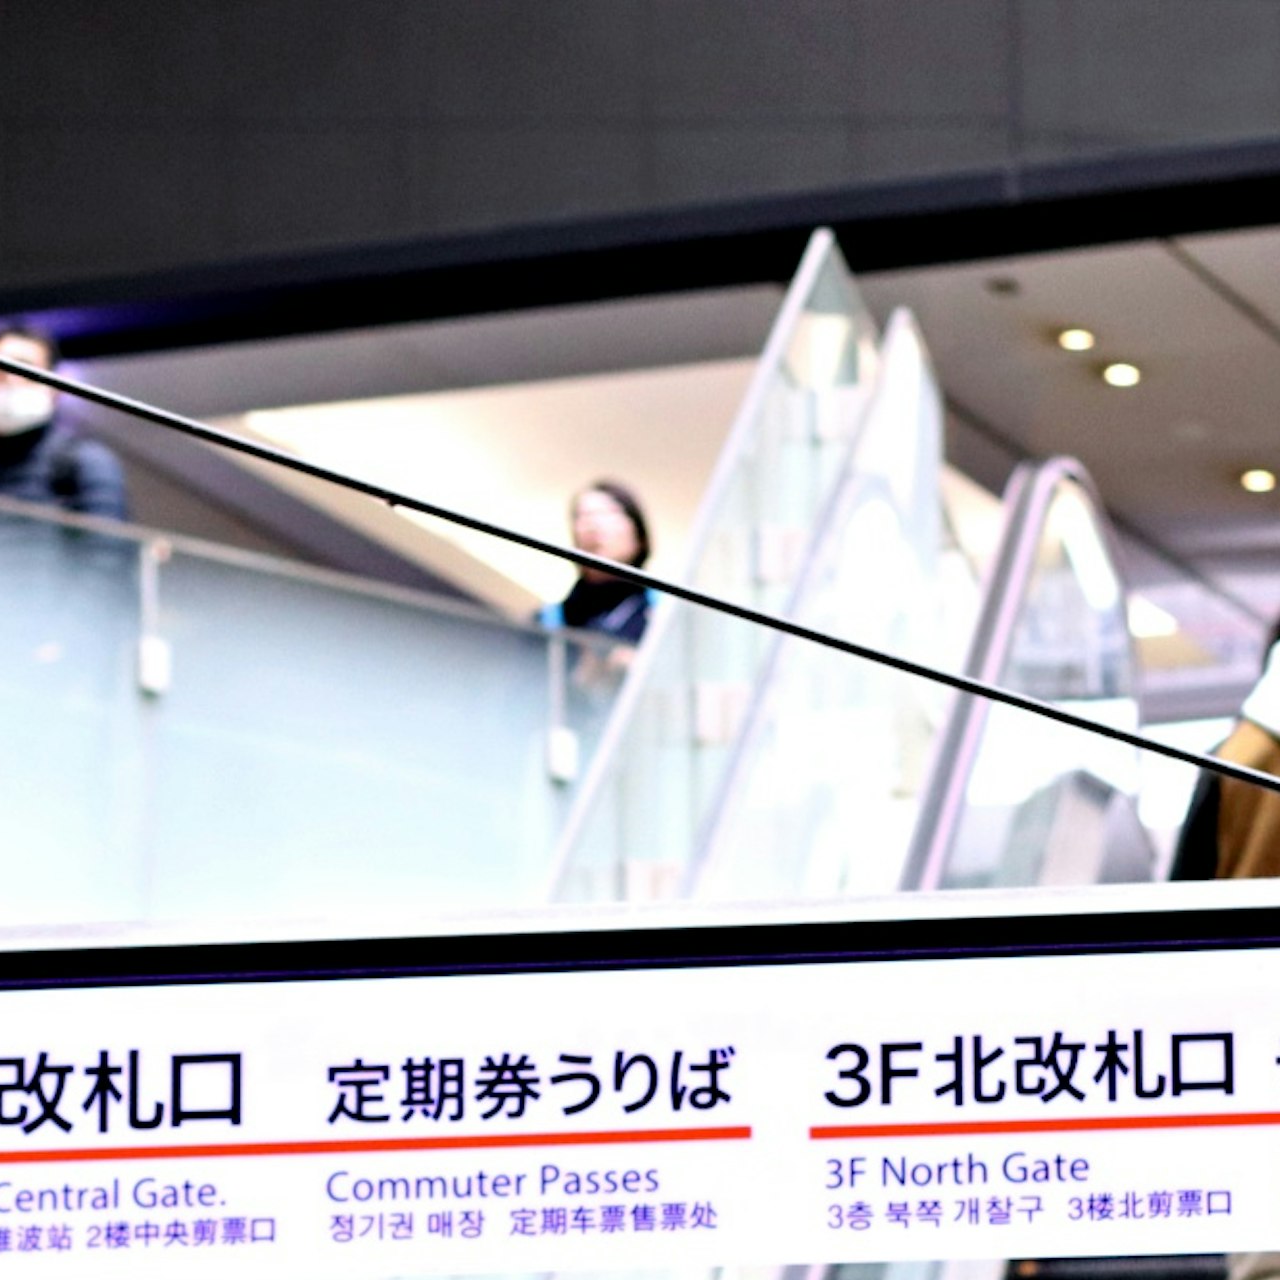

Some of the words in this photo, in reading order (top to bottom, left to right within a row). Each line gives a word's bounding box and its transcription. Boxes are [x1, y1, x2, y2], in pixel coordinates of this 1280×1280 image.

[327, 1046, 735, 1124] 定期券うりば
[824, 1029, 1234, 1108] 3F北改札口
[326, 1170, 526, 1202] Commuter
[540, 1164, 659, 1195] Passes
[826, 1157, 866, 1189] 3F
[882, 1153, 988, 1187] North
[1002, 1152, 1089, 1183] Gate
[132, 1178, 226, 1209] Gate.
[1068, 1189, 1231, 1221] 3楼北剪票口
[330, 1212, 413, 1243] 정기권
[428, 1210, 485, 1238] 매장
[510, 1202, 717, 1236] 定期车票售票处
[828, 1201, 874, 1231] 3층
[885, 1200, 942, 1228] 북쪽
[954, 1196, 1043, 1225] 개찰구
[87, 1217, 275, 1248] 2楼中央剪票口
